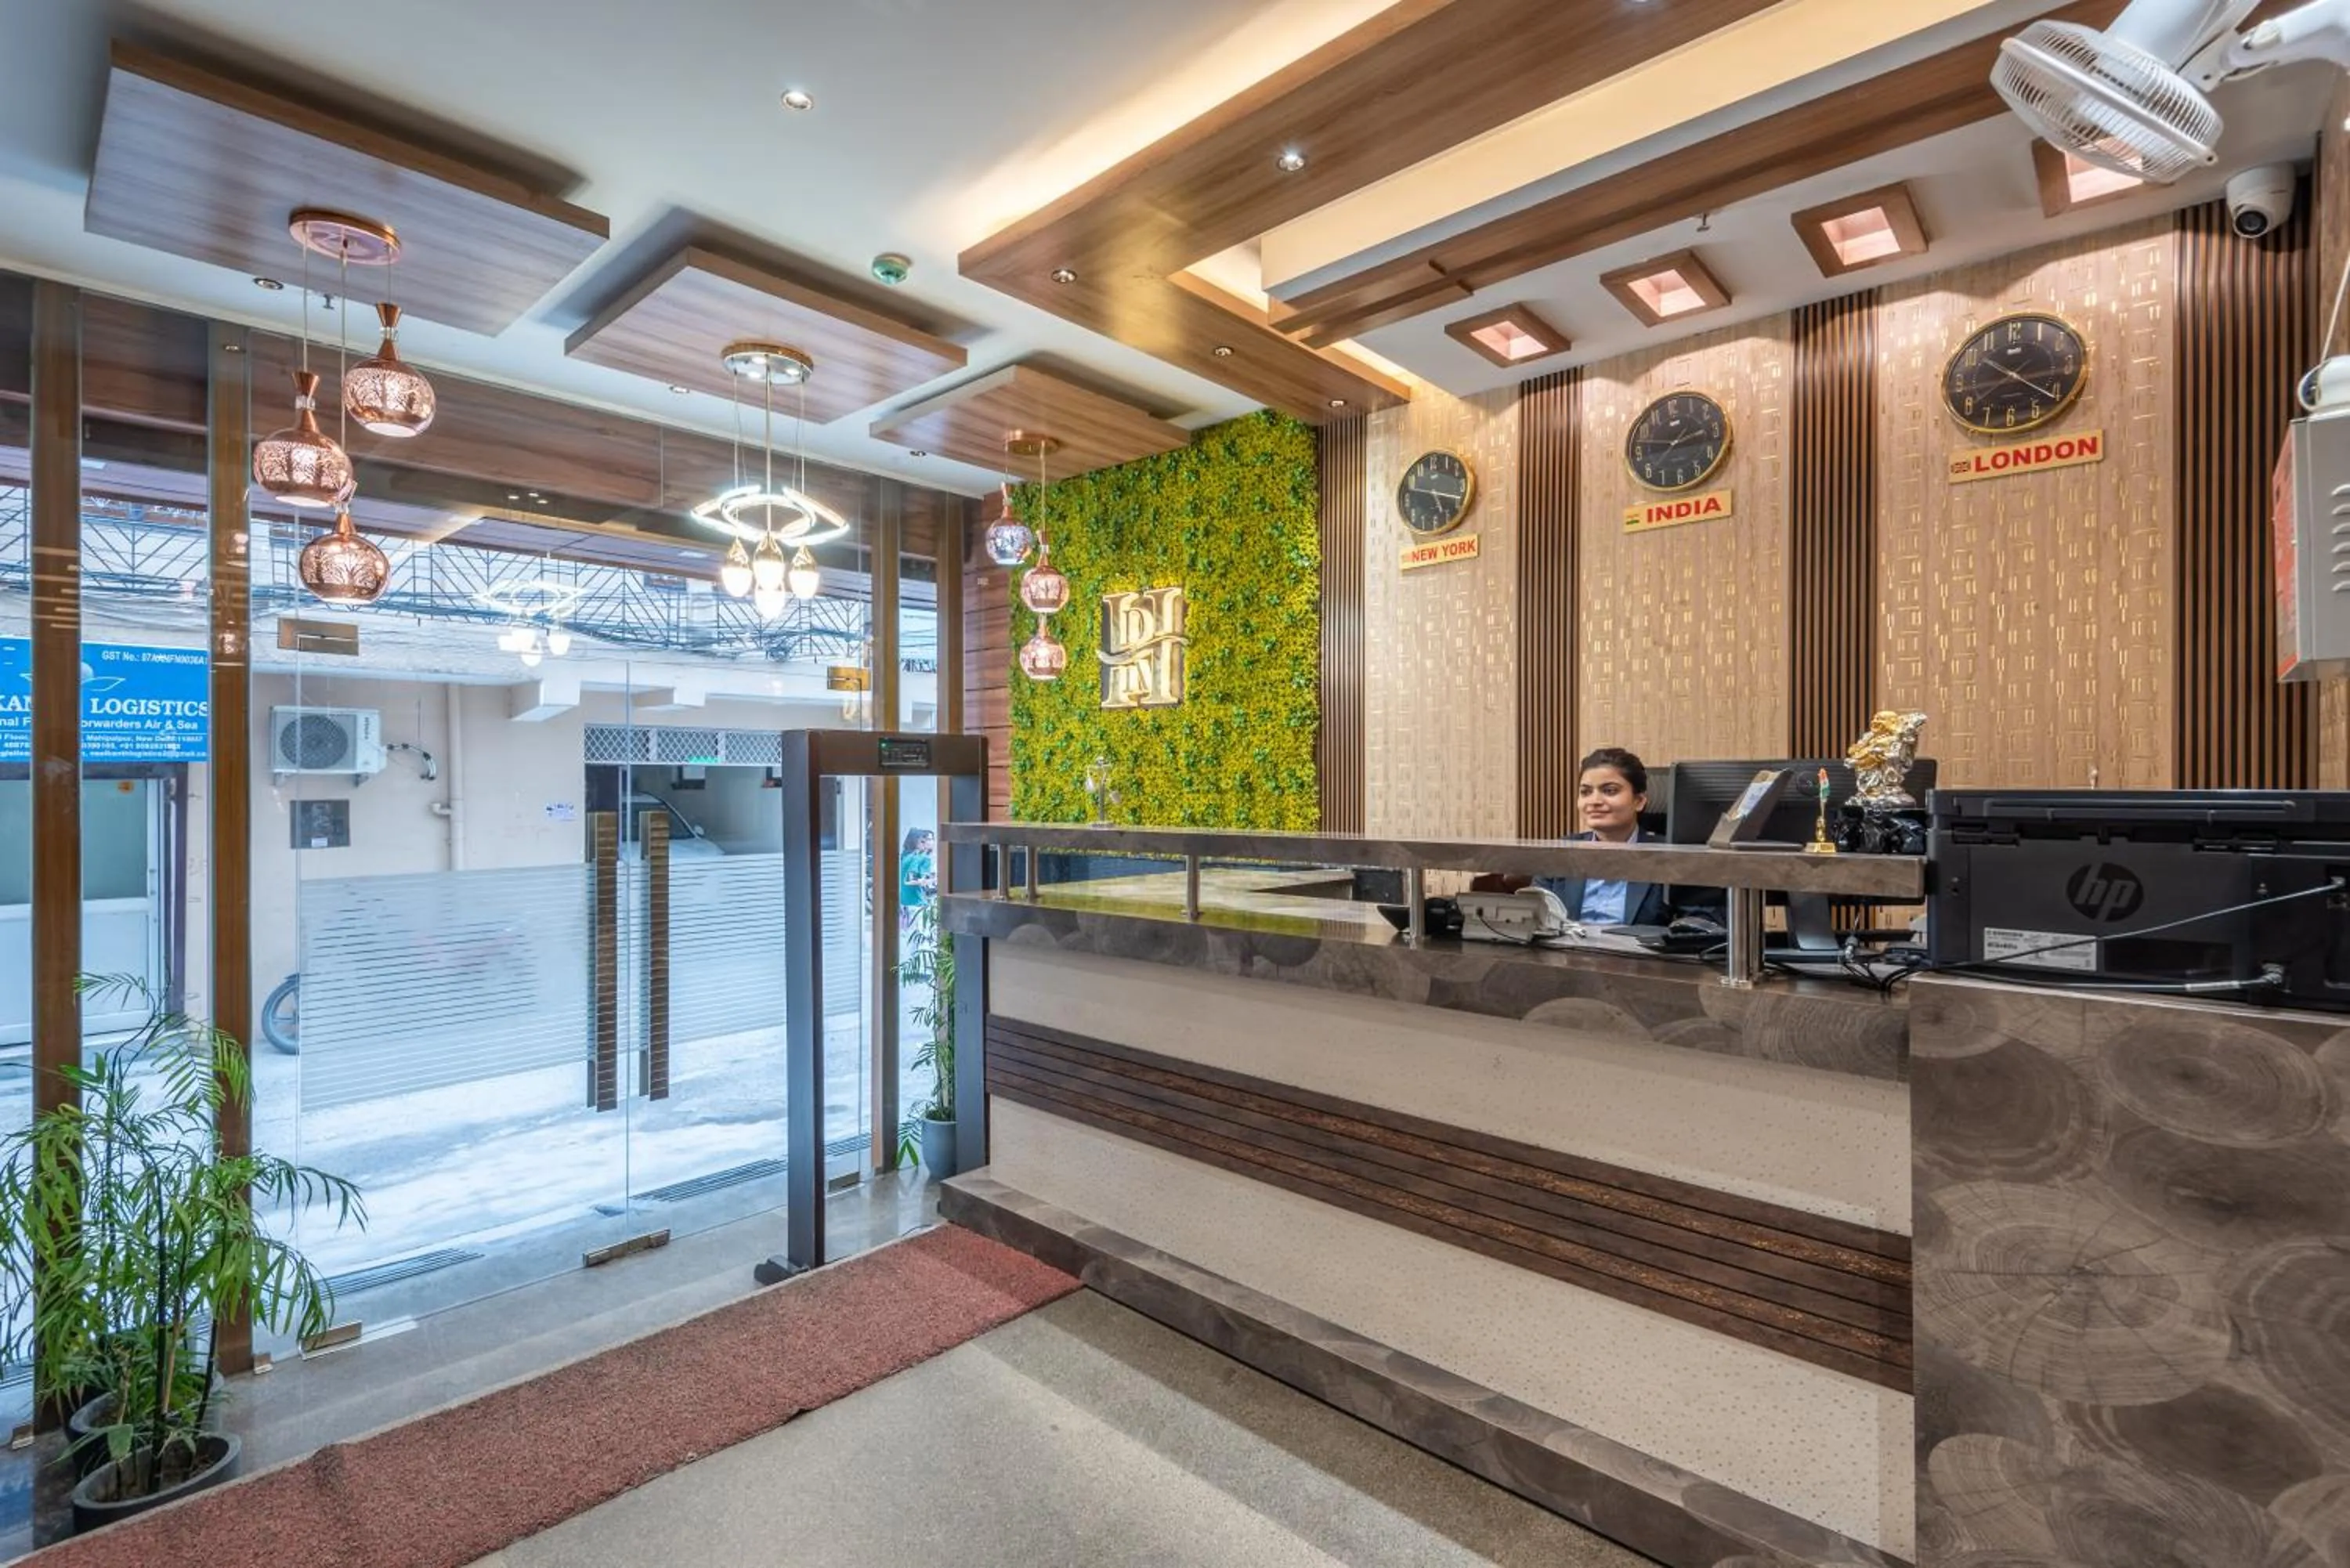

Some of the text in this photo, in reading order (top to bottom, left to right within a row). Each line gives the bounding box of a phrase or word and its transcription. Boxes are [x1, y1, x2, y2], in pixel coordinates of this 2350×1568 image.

[1984, 331, 1994, 351] 11
[1965, 396, 1973, 415] 8
[2031, 398, 2039, 419] 5
[1983, 406, 1991, 426] 7
[2006, 406, 2015, 427] 6
[1975, 436, 2098, 472] LONDON
[1659, 470, 1665, 486] 7
[1647, 497, 1722, 523] INDIA
[1412, 538, 1477, 563] NEW YORK
[102, 651, 120, 660] GST
[90, 698, 207, 717] LOGISTICS
[81, 718, 141, 729] orwarders
[144, 719, 162, 729] Air
[177, 721, 198, 730] Sea
[2070, 862, 2140, 923] hp
